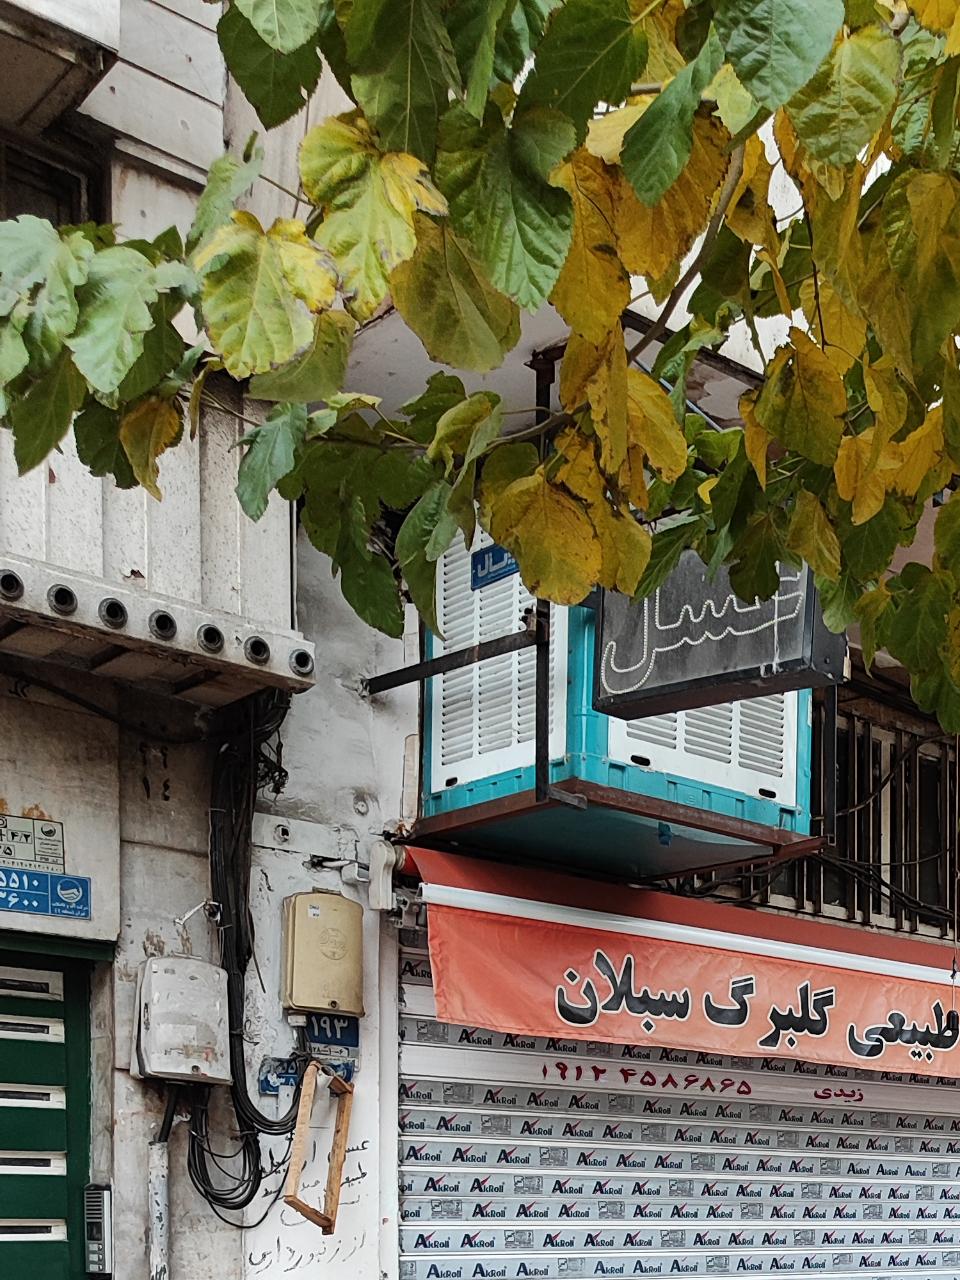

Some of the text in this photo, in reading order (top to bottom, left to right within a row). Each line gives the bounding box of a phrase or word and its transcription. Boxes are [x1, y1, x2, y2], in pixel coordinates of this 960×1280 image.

[401, 960, 432, 979] AkRo
[555, 948, 692, 1035] سبلان
[310, 1015, 349, 1039] ۱۹۳
[847, 999, 960, 1061] طبیعی
[619, 1067, 752, 1096] ۴۵۸۶۸۶۵
[813, 1087, 865, 1103] زیدی
[435, 1115, 472, 1132] AkRoll
[404, 1144, 442, 1161] AkRoll
[451, 1146, 487, 1163] AkRoll
[423, 1176, 460, 1192] AkRoll
[469, 1177, 504, 1193] AkRoll
[471, 1202, 506, 1218] AkRoll
[413, 1232, 450, 1248] AkRoll
[459, 1232, 495, 1248] AkRoll
[426, 1263, 462, 1279] AkRoll
[471, 1262, 506, 1278] AkRoll
